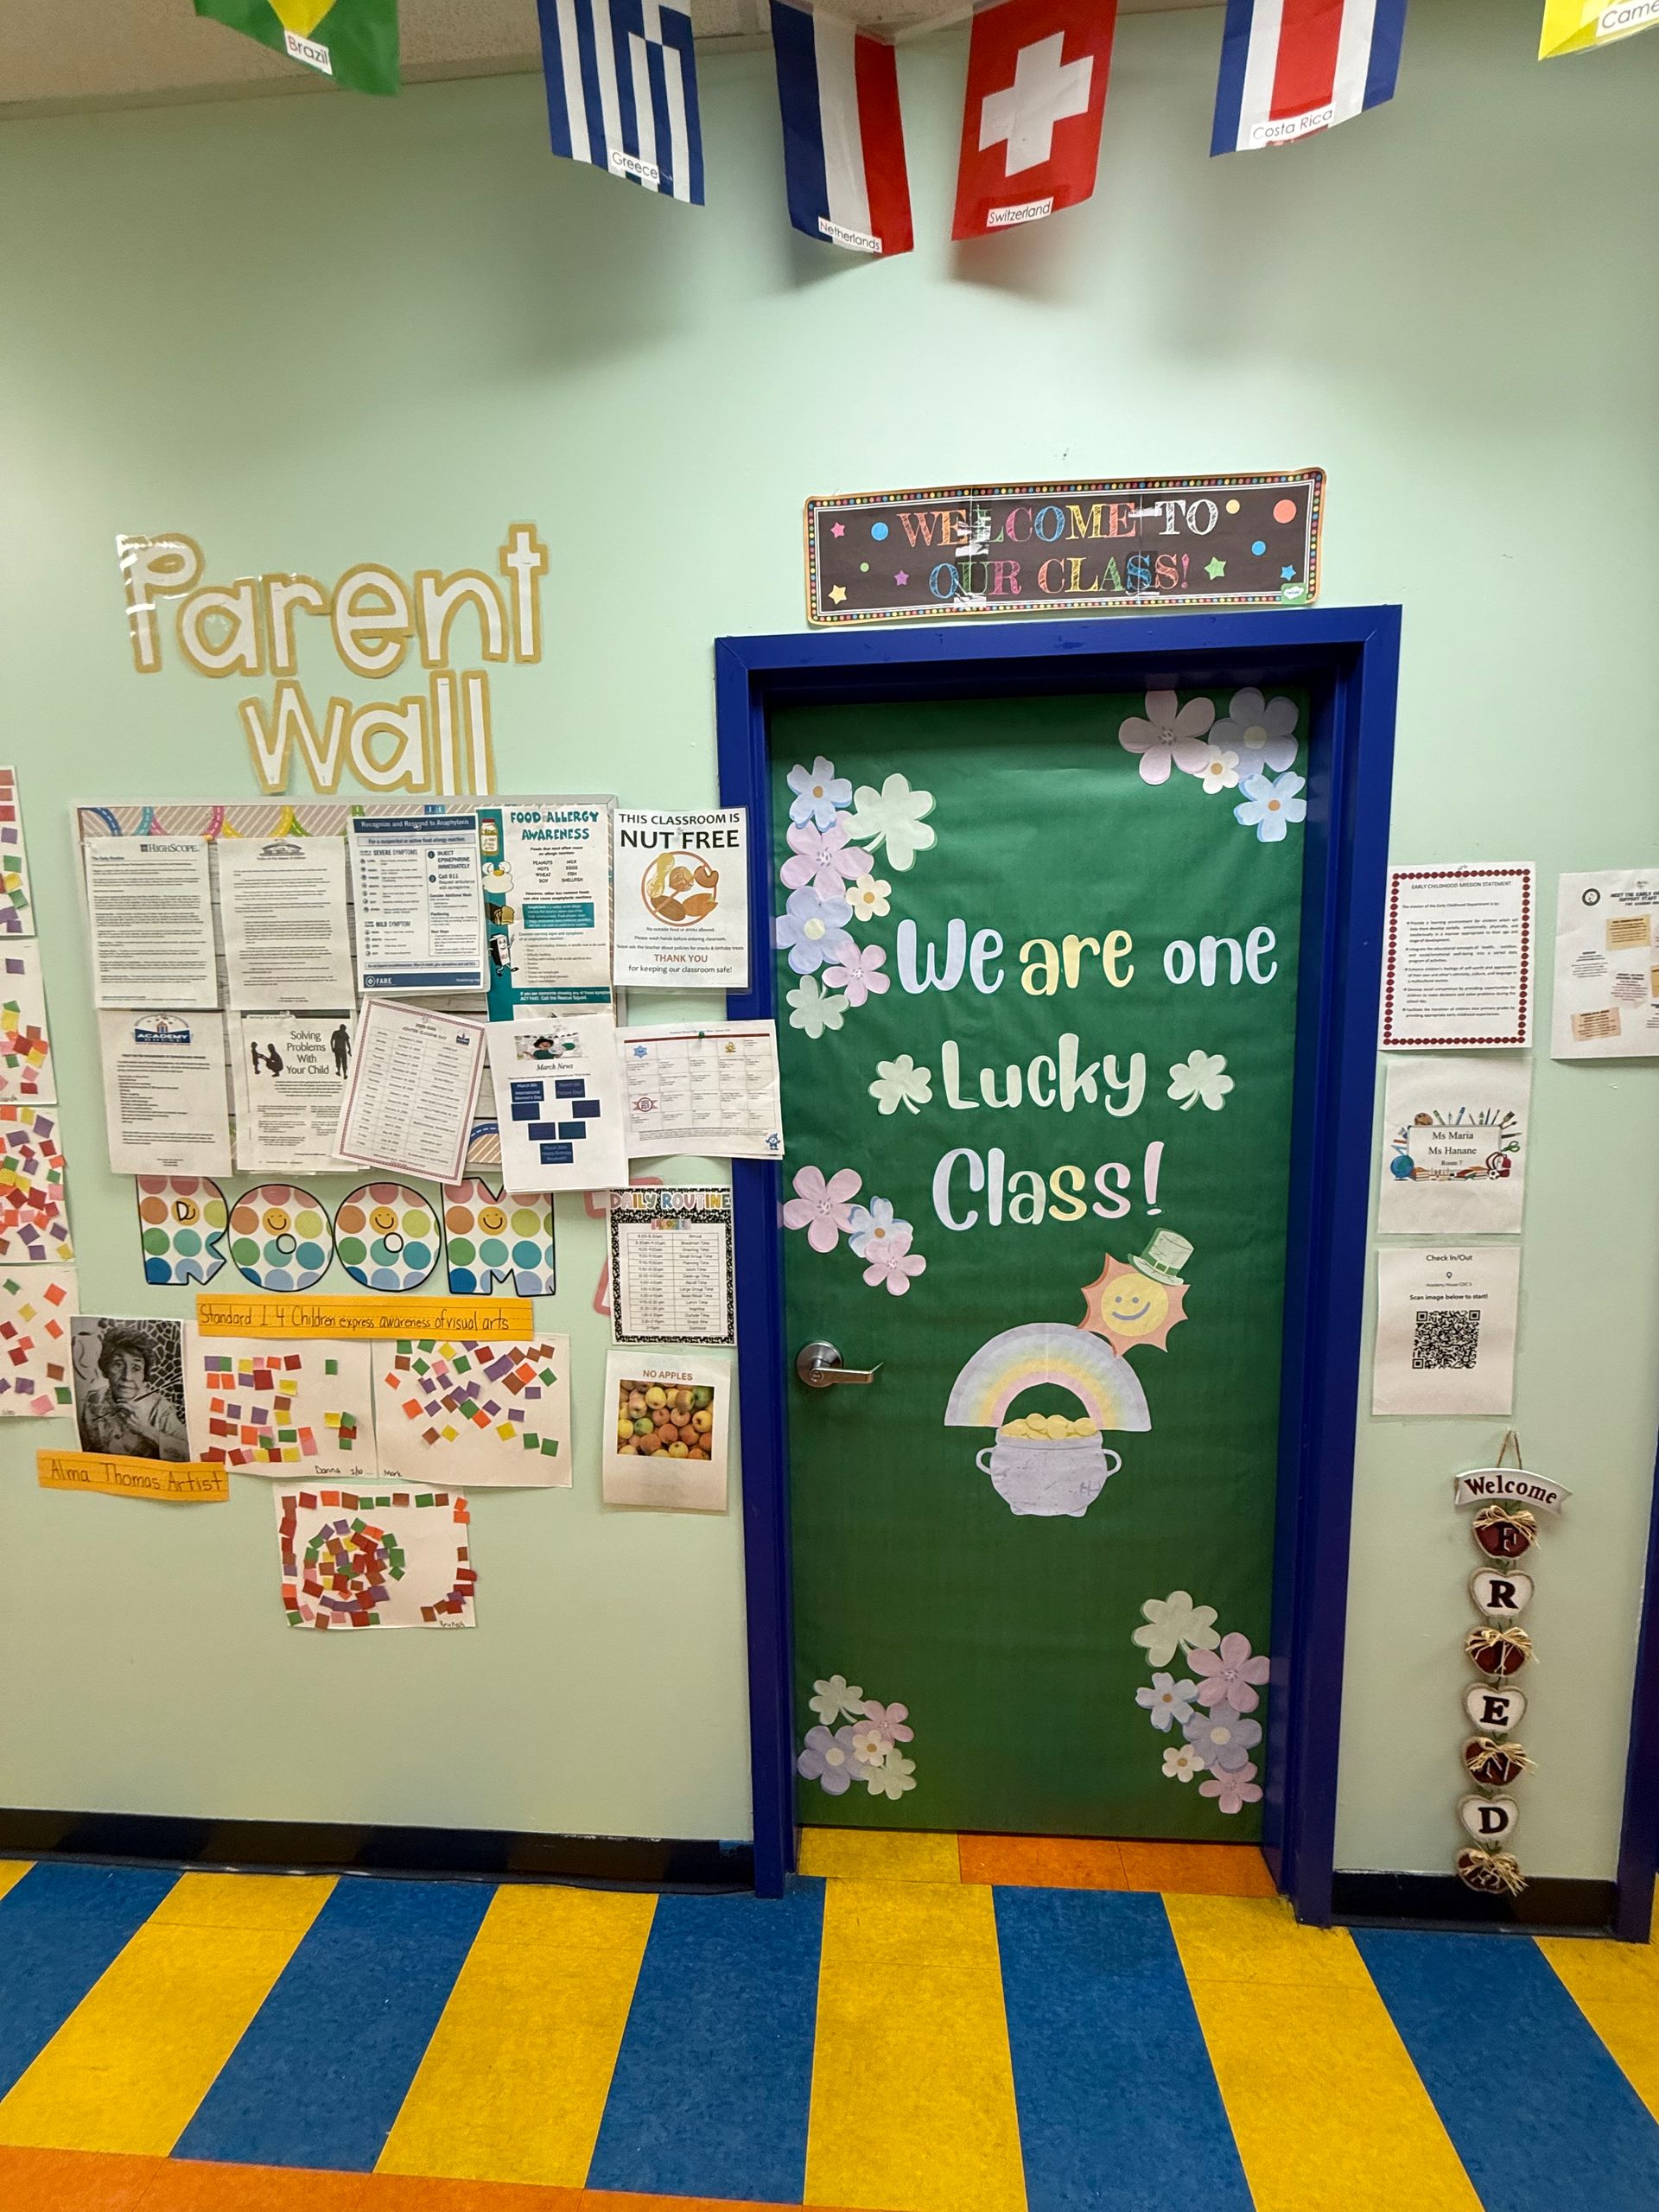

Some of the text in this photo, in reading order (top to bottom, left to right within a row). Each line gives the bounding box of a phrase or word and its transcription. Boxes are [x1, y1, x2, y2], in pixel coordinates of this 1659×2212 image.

[288, 35, 328, 66] Brazil
[1253, 109, 1333, 139] Costa Rica
[612, 151, 658, 179] Greece
[988, 201, 1051, 224] Switzerland
[820, 221, 880, 251] Netherlands
[895, 499, 1218, 547] WELCOME TO
[929, 553, 1191, 599] OUR CLASS!
[117, 523, 549, 678] Parent
[238, 670, 496, 796] Wall
[511, 810, 599, 823] FOOD ALLERGY
[619, 813, 740, 825] THIS CLASSROOM IS
[521, 828, 589, 841] AWARENESS
[620, 830, 740, 849] NUT FREE
[654, 954, 708, 963] THANK YOU
[897, 918, 1278, 995] We are one
[639, 965, 668, 975] keeping
[287, 1042, 327, 1052] Problems
[290, 1030, 321, 1042] Solving
[286, 1064, 329, 1075] Your Child
[297, 1053, 317, 1064] With
[941, 1033, 1147, 1116] Lucky
[1432, 1131, 1474, 1140] Ms Maria
[1428, 1147, 1442, 1155] Ms
[932, 1141, 1165, 1231] Class!
[610, 1192, 731, 1209] DAILY ROUTINE
[200, 1304, 251, 1325] Standard
[276, 1305, 285, 1327] 4
[292, 1305, 335, 1327] Children
[340, 1313, 374, 1332] express
[379, 1315, 431, 1329] awareness
[482, 1308, 510, 1331] arts
[658, 1371, 693, 1381] APPLES
[51, 1459, 223, 1492] Alma Thomas Artist
[1464, 1475, 1558, 1504] Welcome
